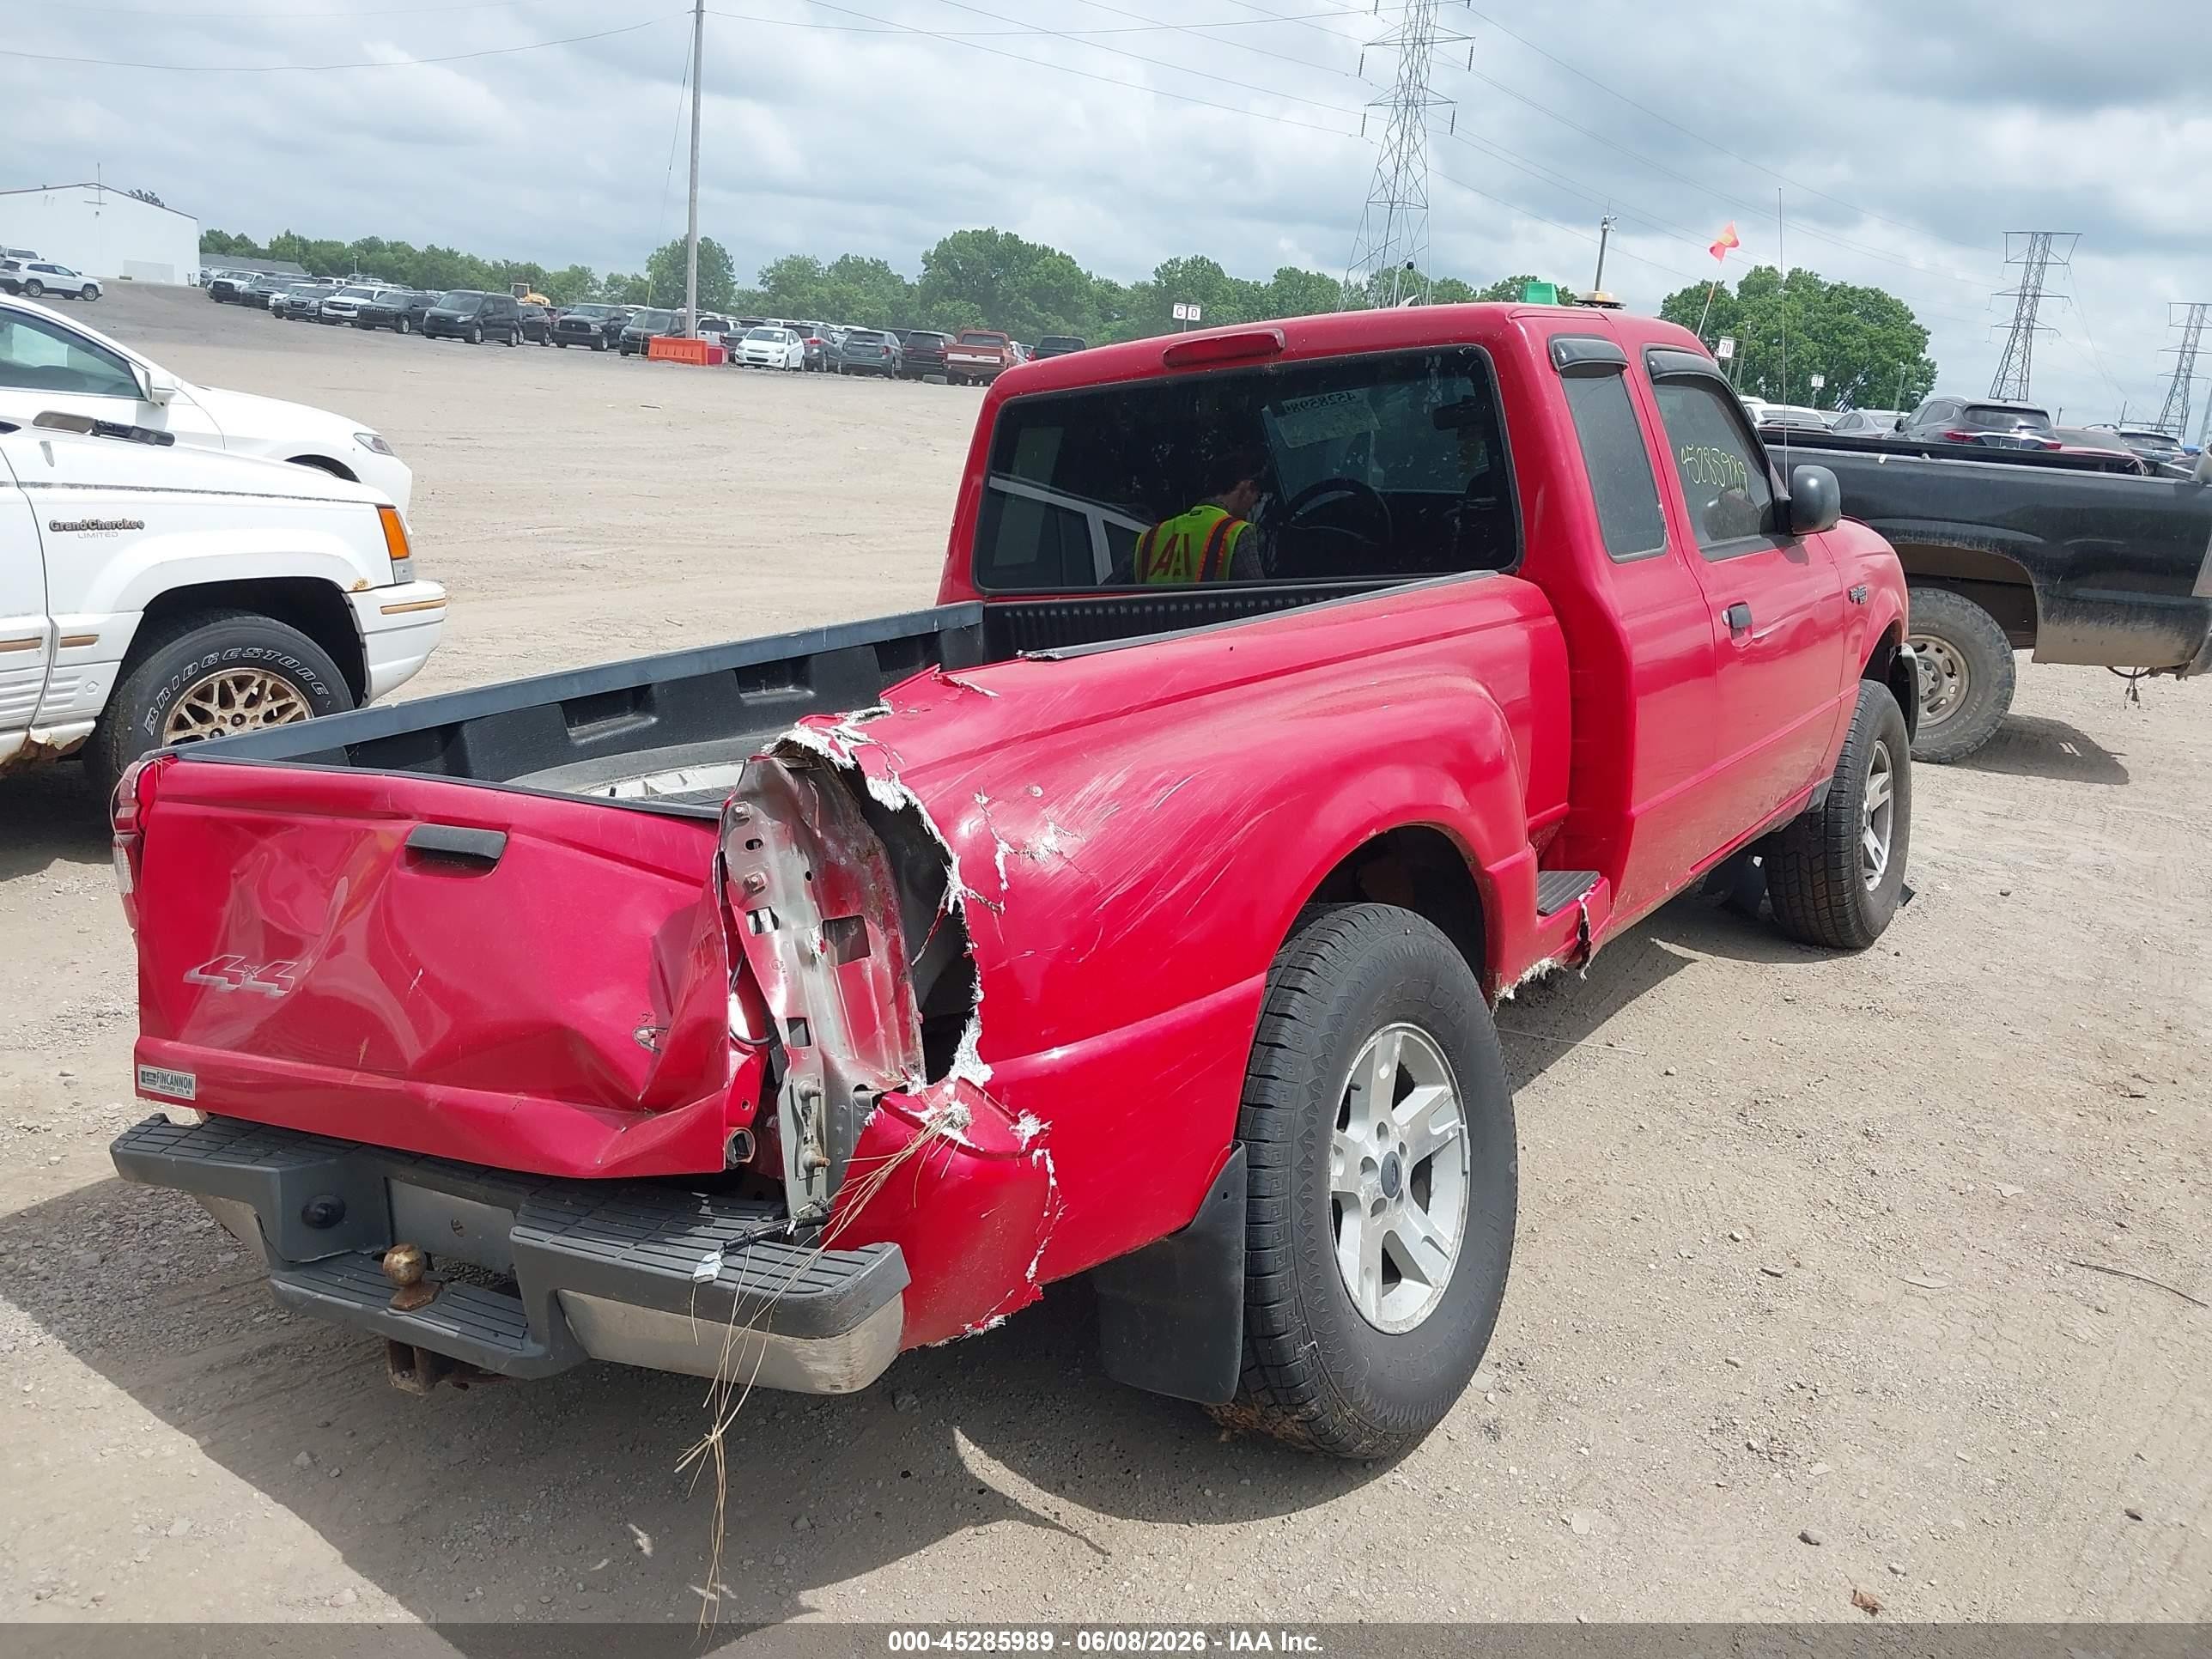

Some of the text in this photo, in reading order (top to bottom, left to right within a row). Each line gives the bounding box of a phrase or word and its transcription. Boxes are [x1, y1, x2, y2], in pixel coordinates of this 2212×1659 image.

[1176, 307, 1198, 319] C D
[1721, 343, 1731, 354] 70
[143, 647, 330, 737] BRIDGESTONE
[156, 1071, 193, 1091] FINCANNON
